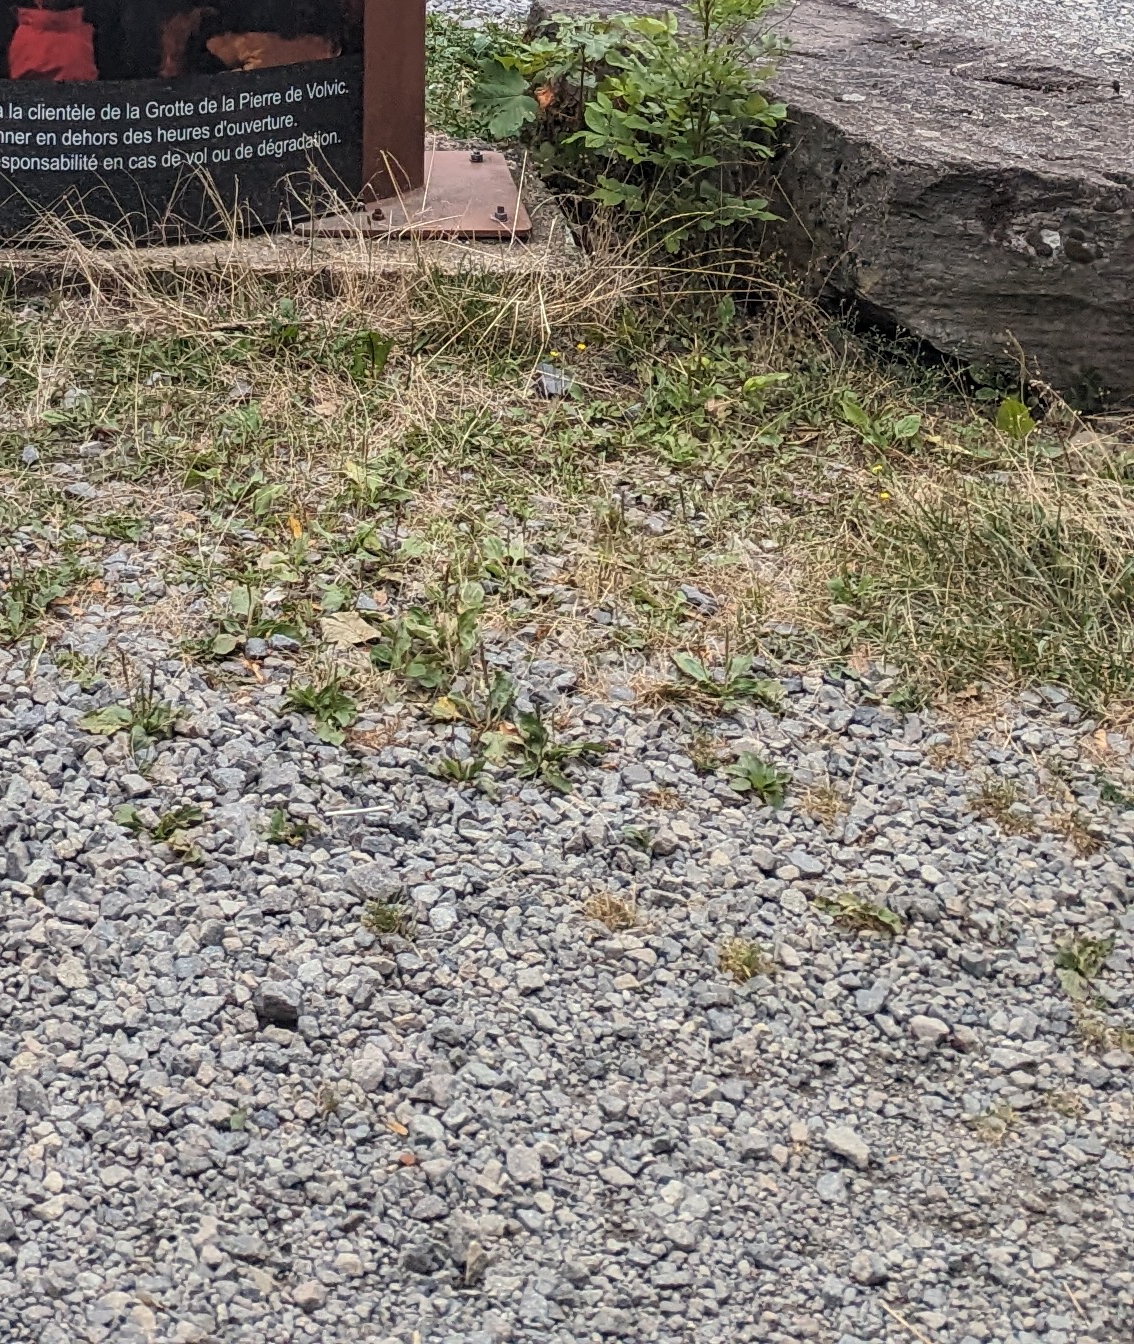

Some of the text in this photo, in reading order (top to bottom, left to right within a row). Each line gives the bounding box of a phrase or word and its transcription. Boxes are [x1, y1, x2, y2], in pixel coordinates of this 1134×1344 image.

[8, 103, 23, 120] la
[27, 103, 96, 121] clientèle
[100, 103, 121, 120] de
[126, 103, 140, 120] la
[145, 100, 194, 119] Grotte
[198, 97, 217, 114] de
[221, 95, 235, 112] la
[239, 91, 282, 111] Pierre
[285, 86, 303, 103] de
[306, 78, 349, 100] Volvic.
[36, 131, 57, 146] en
[61, 128, 118, 146] dehors
[122, 127, 153, 145] des
[156, 123, 210, 143] heures
[214, 113, 299, 138] d'ouverture.
[102, 156, 124, 171] en
[128, 154, 157, 170] cas
[161, 150, 182, 168] de
[186, 146, 208, 165] vol
[211, 147, 231, 163] ou
[234, 141, 254, 159] de
